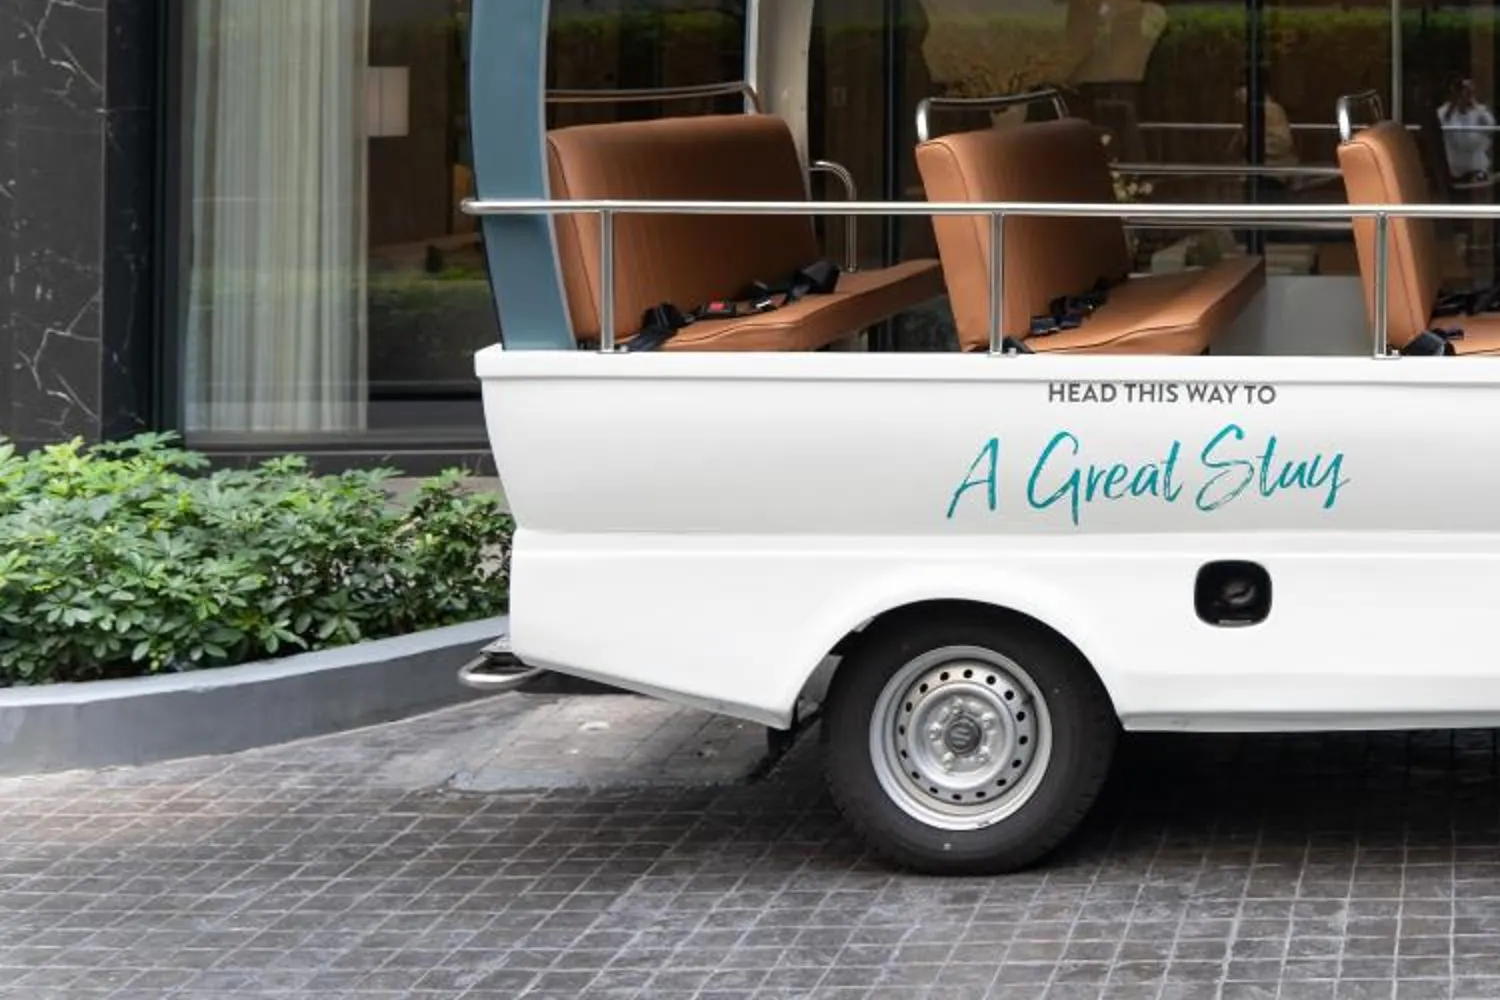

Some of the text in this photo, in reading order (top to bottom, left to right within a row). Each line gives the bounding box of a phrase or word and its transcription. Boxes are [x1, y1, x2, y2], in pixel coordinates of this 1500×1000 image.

[1048, 382, 1277, 405] HEAD THIS WAY TO
[946, 423, 1352, 526] A Great Stay
